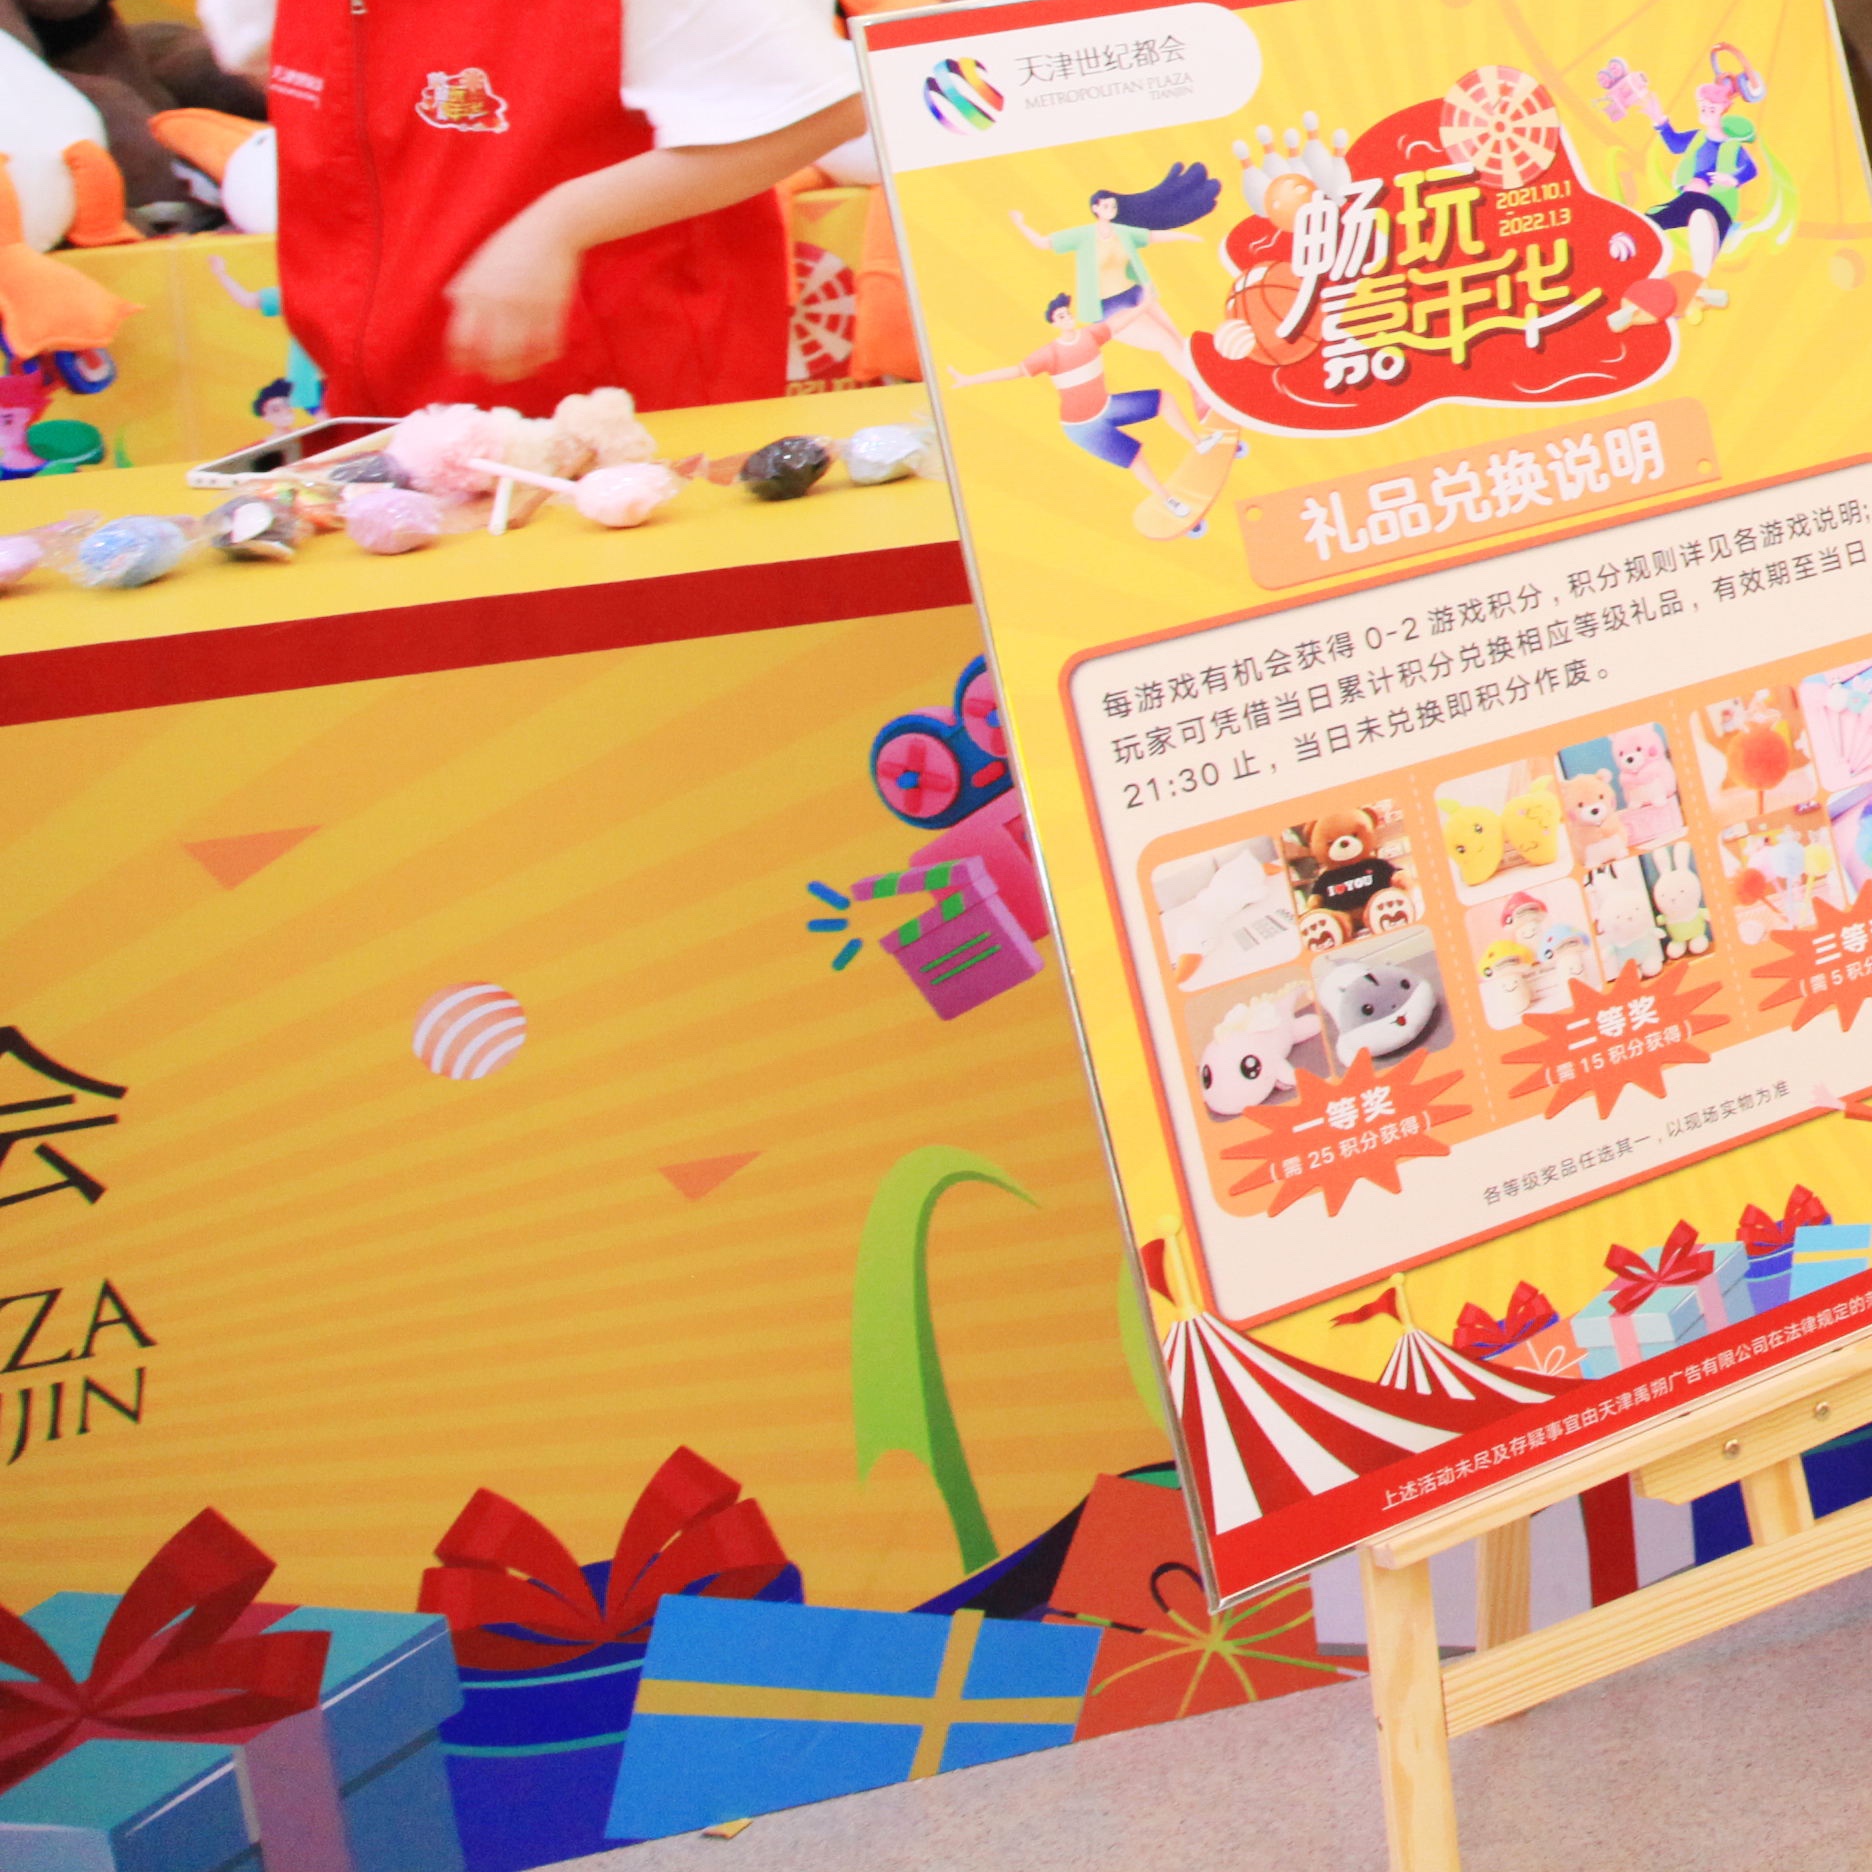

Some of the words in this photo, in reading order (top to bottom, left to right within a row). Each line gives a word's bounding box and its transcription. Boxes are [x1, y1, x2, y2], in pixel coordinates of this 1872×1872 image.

[1015, 34, 1186, 87] 天津世纪都会
[1025, 79, 1144, 109] METROPOLITAN
[1147, 72, 1193, 91] PLAZA
[1151, 85, 1194, 101] TIANJIN
[1495, 180, 1572, 210] 2021.10.1
[1498, 208, 1572, 237] 2022.1.3
[1297, 418, 1668, 562] 礼品兑换说明
[1101, 631, 1357, 720] 每游戏有机会获得
[1364, 616, 1420, 653] 0-2
[1123, 761, 1222, 810] 21:30
[1566, 995, 1660, 1051] 二等奖
[1292, 1085, 1396, 1134] 一等奖
